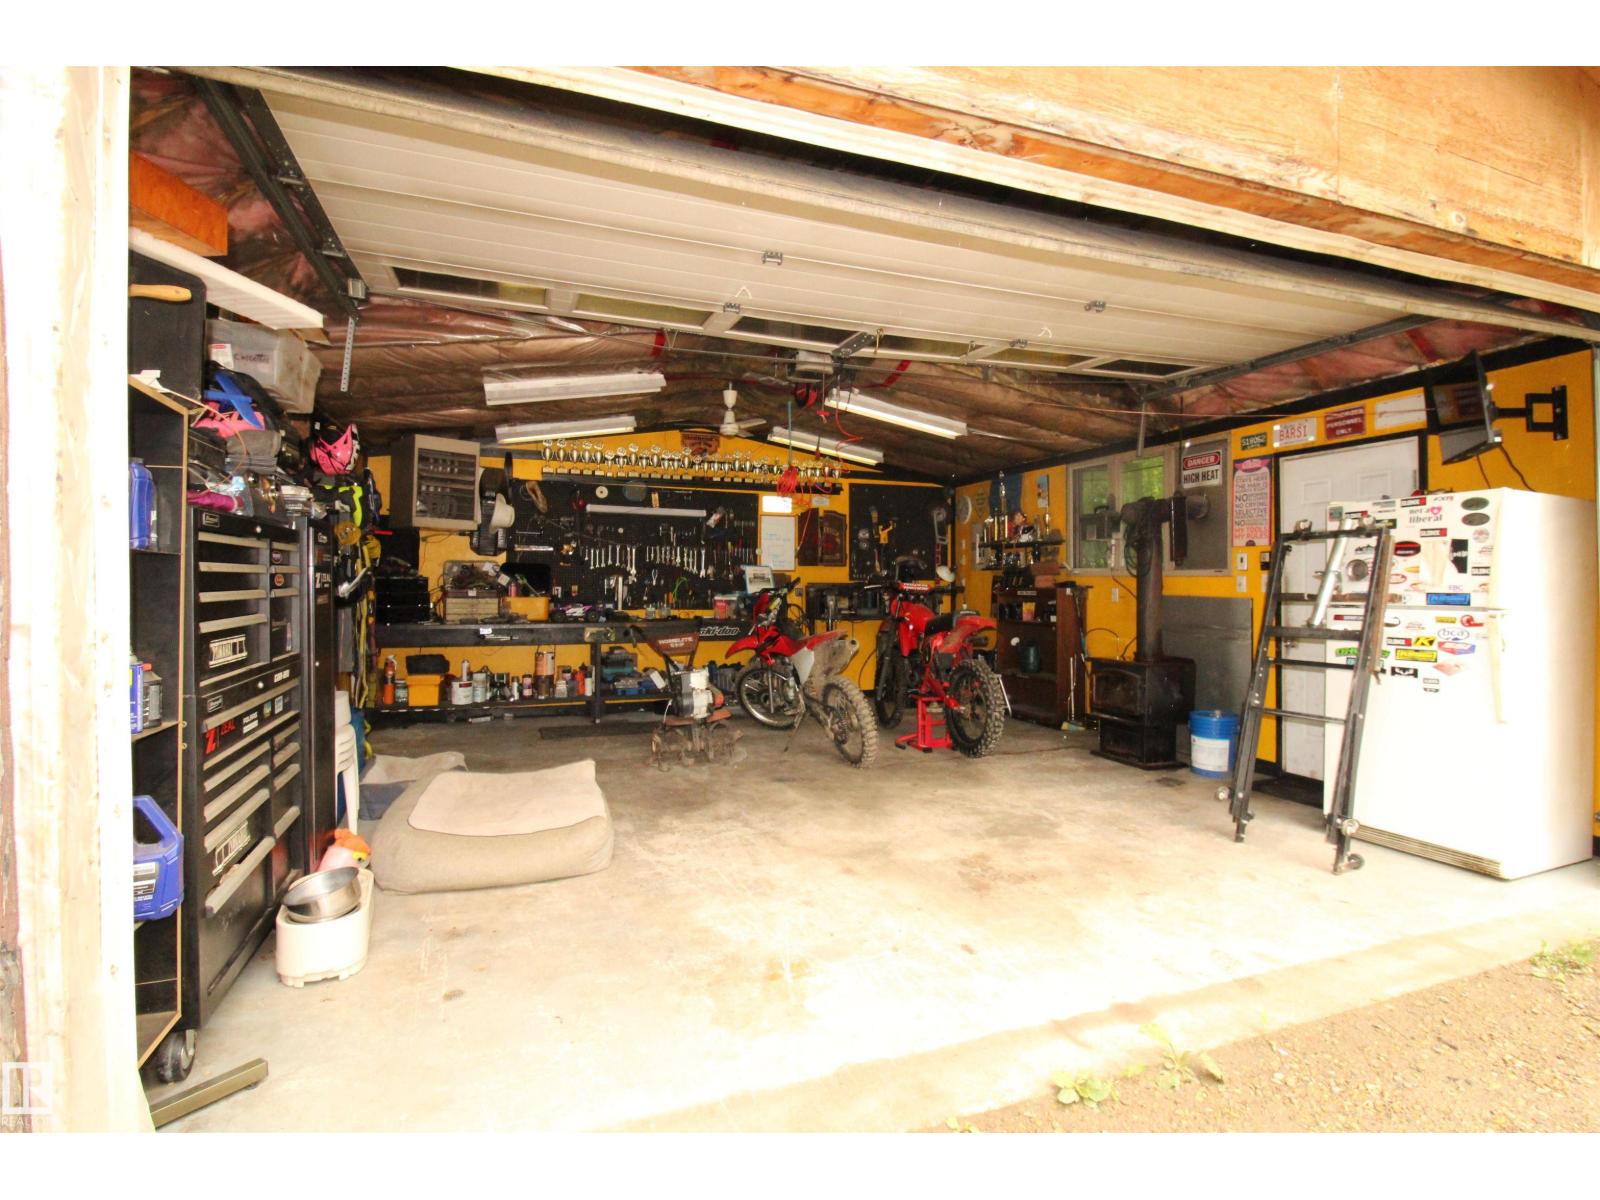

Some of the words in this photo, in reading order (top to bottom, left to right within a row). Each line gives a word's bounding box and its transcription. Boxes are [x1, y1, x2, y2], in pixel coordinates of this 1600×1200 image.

[1187, 456, 1216, 467] DANGER
[1183, 471, 1200, 484] HIGH
[1202, 469, 1219, 481] HEAT
[1235, 493, 1248, 502] NO
[1409, 515, 1443, 523] liberal
